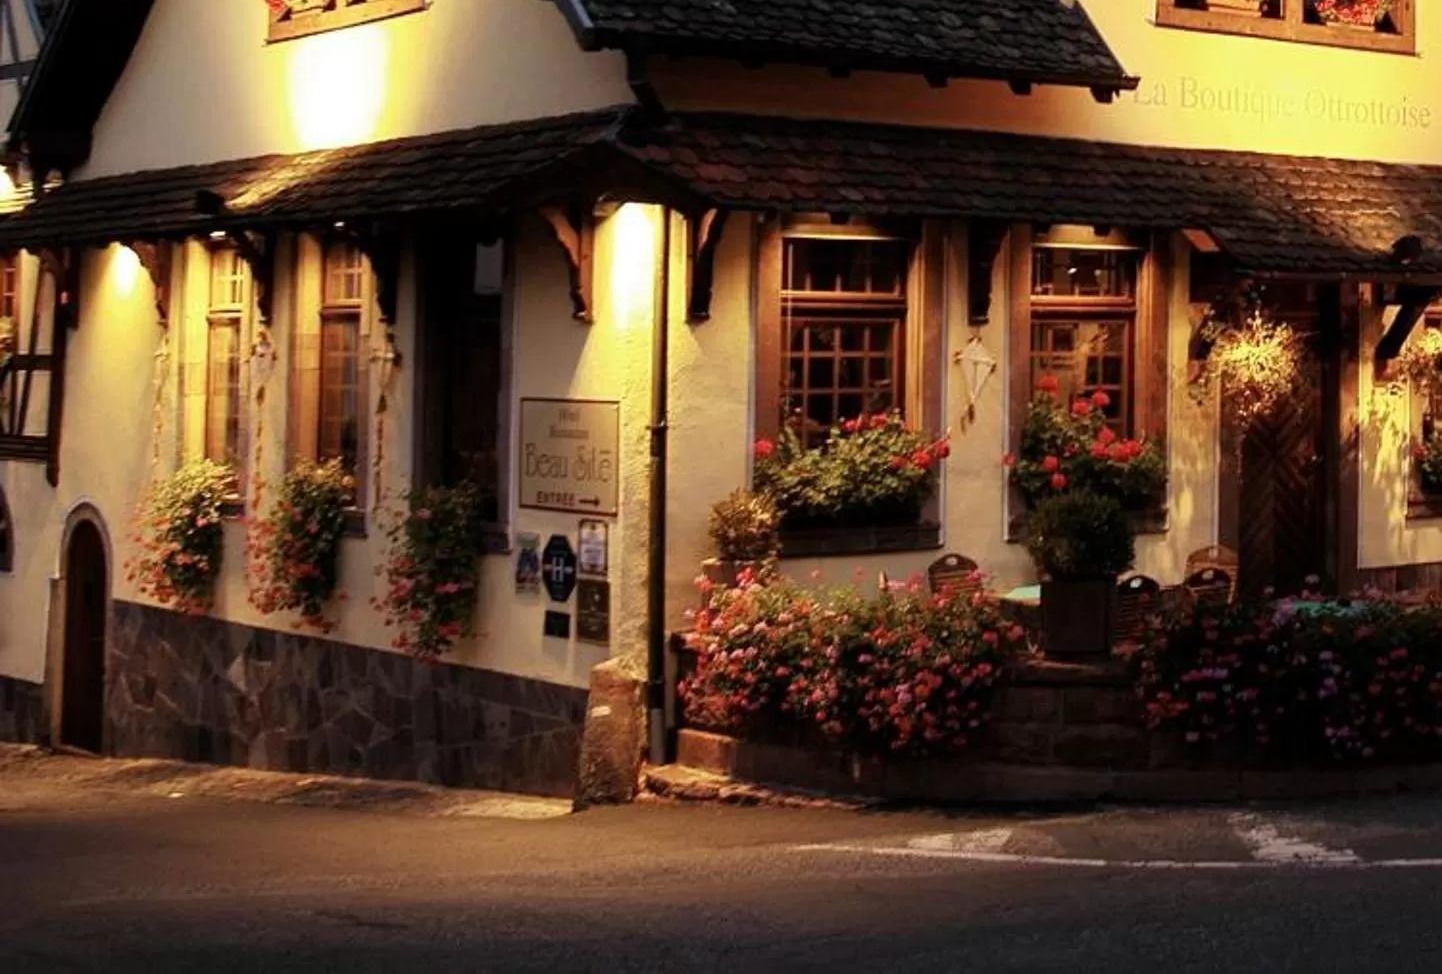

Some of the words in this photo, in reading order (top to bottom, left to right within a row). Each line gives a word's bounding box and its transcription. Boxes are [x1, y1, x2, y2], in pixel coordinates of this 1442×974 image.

[1180, 76, 1294, 122] Boutique
[525, 442, 569, 478] Beau
[551, 556, 565, 583] H
